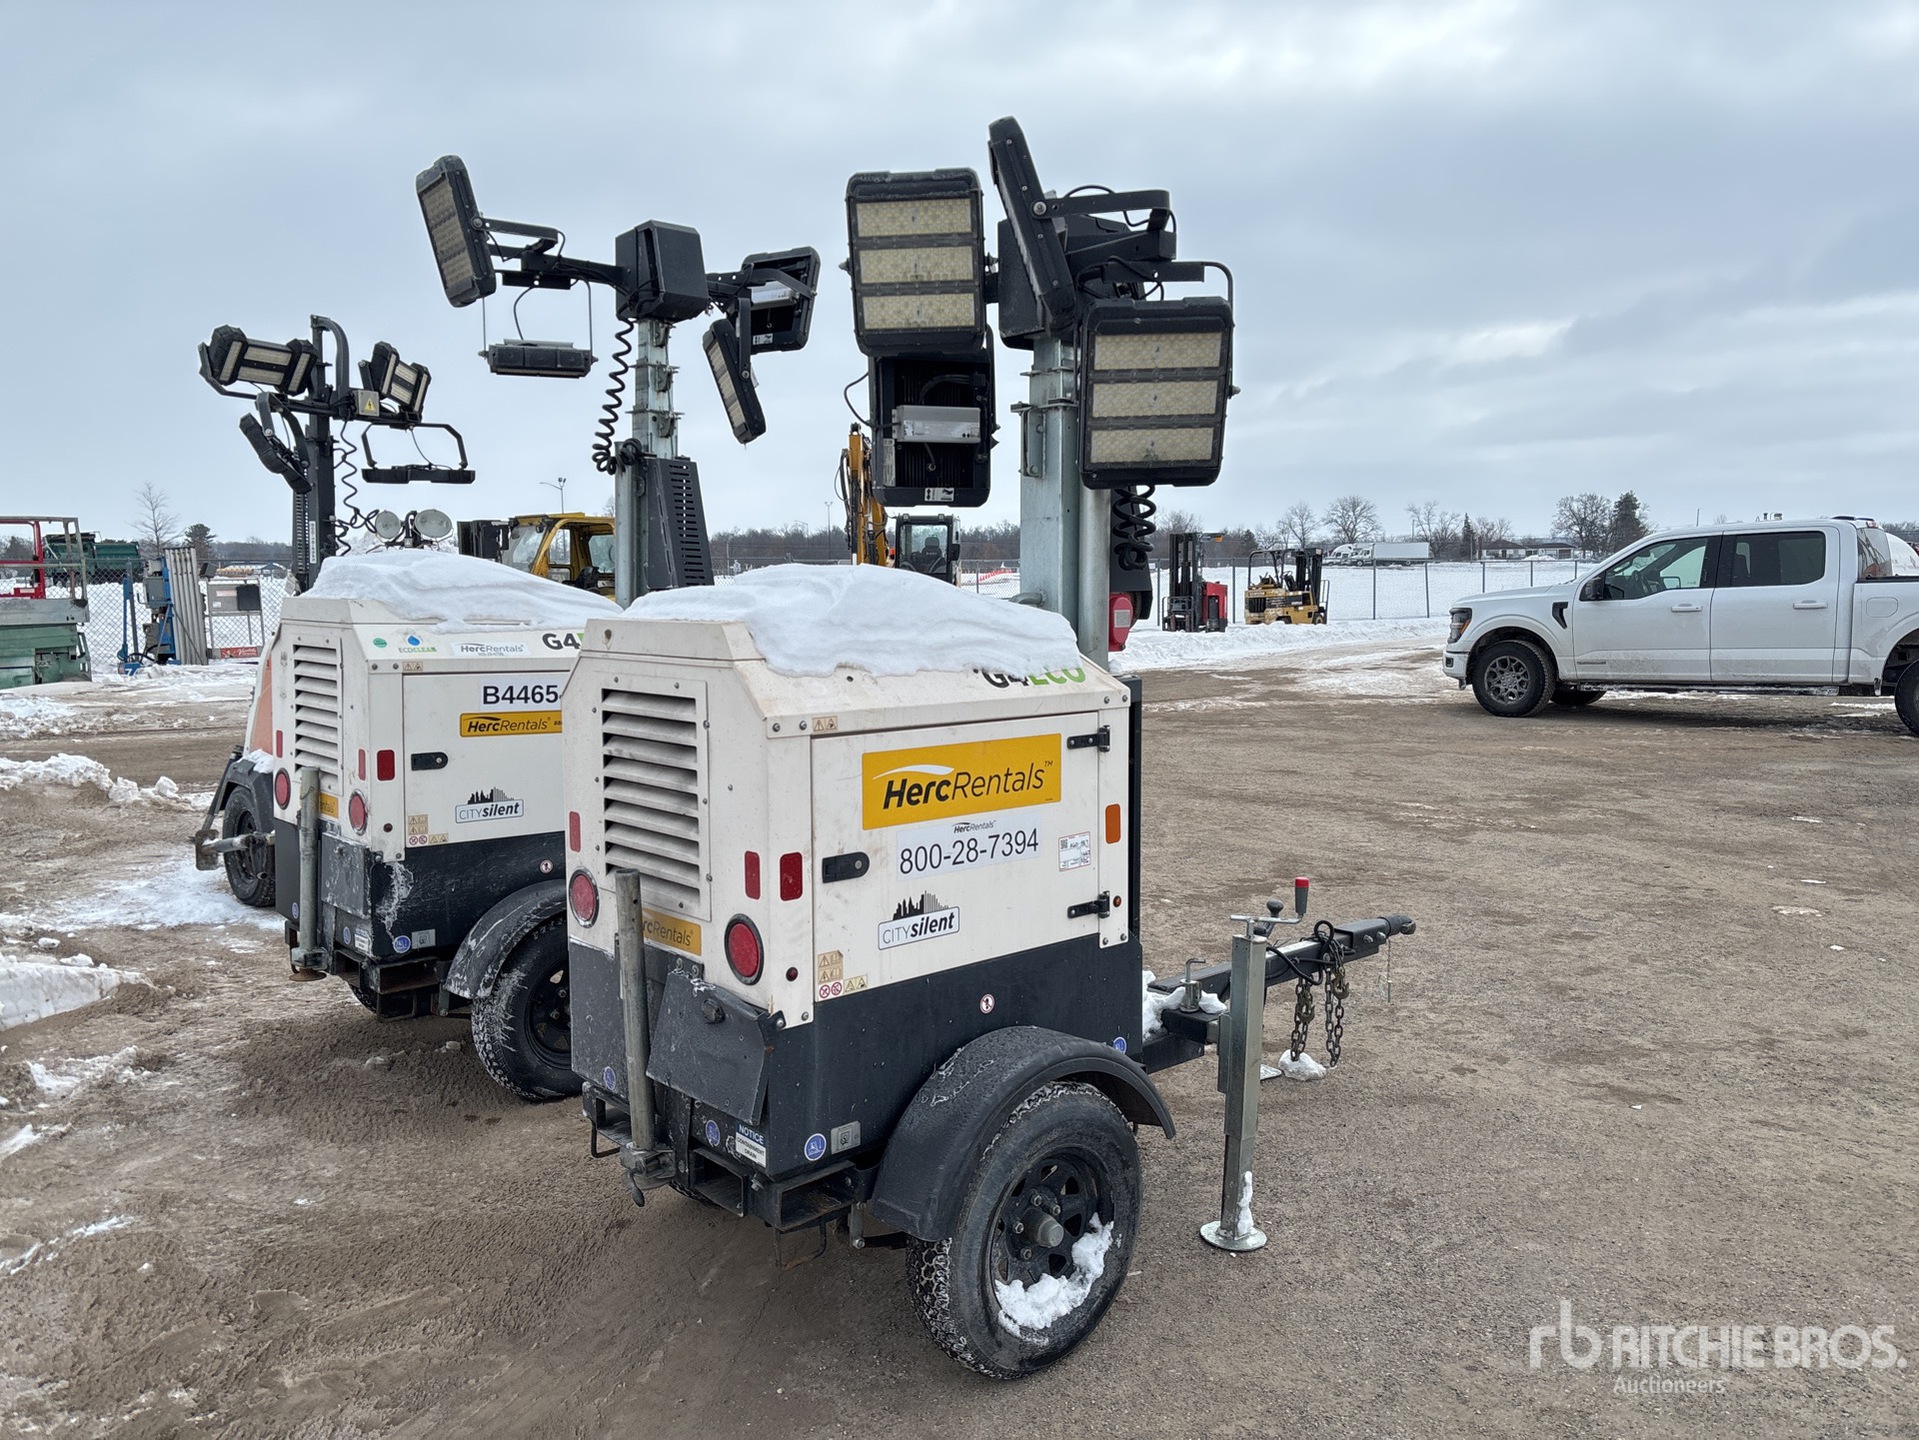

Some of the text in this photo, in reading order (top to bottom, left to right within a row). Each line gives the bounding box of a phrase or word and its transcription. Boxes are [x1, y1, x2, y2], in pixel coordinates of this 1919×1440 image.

[542, 633, 583, 650] G4
[483, 684, 562, 705] B4465
[467, 719, 548, 732] HercRentals
[882, 763, 1045, 809] HercRentals
[459, 802, 520, 820] CITYsilent
[953, 821, 996, 834] HercRentals
[900, 827, 1039, 874] 800-28-7394
[882, 911, 955, 944] CITYsilent
